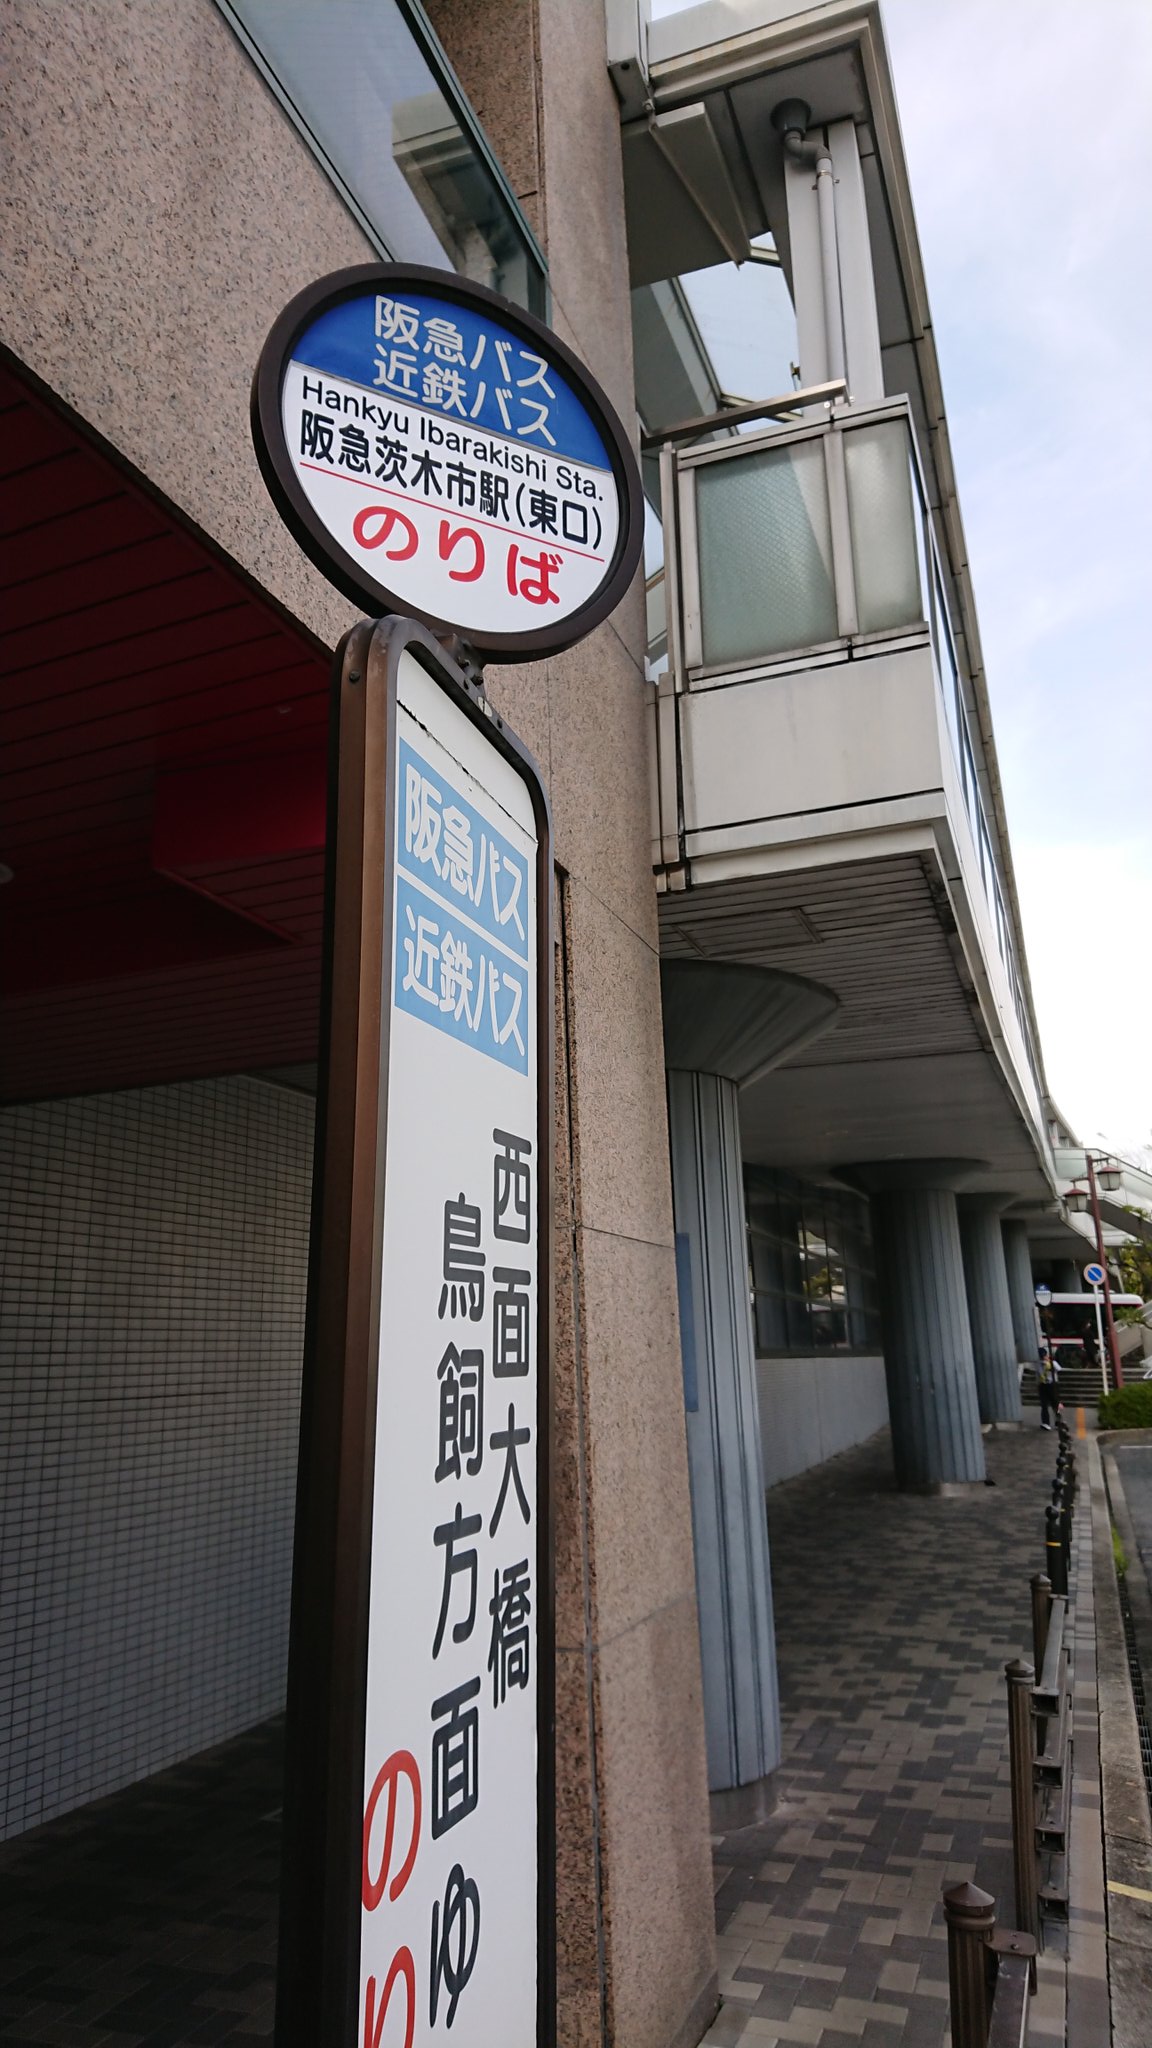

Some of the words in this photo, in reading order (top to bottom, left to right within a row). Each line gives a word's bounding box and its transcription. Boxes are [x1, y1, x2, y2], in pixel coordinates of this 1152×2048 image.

[372, 342, 557, 446] 近鉄バス
[374, 294, 556, 399] 阪急バス
[300, 408, 602, 551] 阪急茨木市駅(東口)
[302, 376, 409, 435] Hankyu
[420, 417, 548, 483] Ibarakishi
[556, 465, 604, 501] Sta.
[352, 505, 564, 606] のりば
[405, 763, 526, 942] 阪急バス
[402, 905, 526, 1057] 近鉄バス
[488, 1127, 532, 1709] 西面大橋
